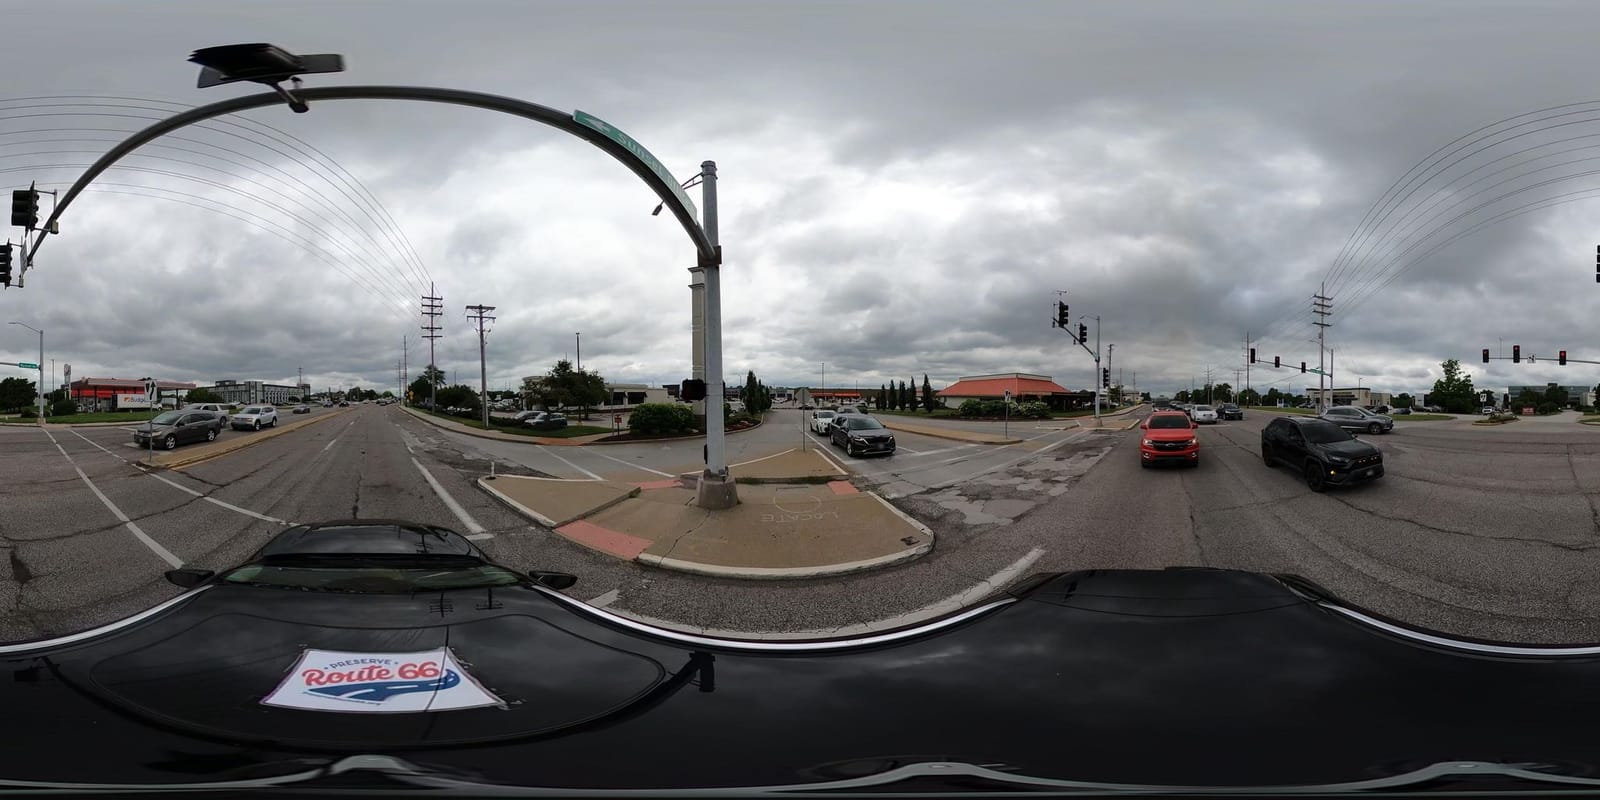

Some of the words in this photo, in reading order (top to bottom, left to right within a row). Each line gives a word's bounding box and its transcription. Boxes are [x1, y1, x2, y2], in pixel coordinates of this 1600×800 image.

[618, 133, 666, 178] Sunset
[302, 665, 392, 686] Route
[397, 662, 440, 679] 66
[330, 658, 393, 669] PRESERVE
